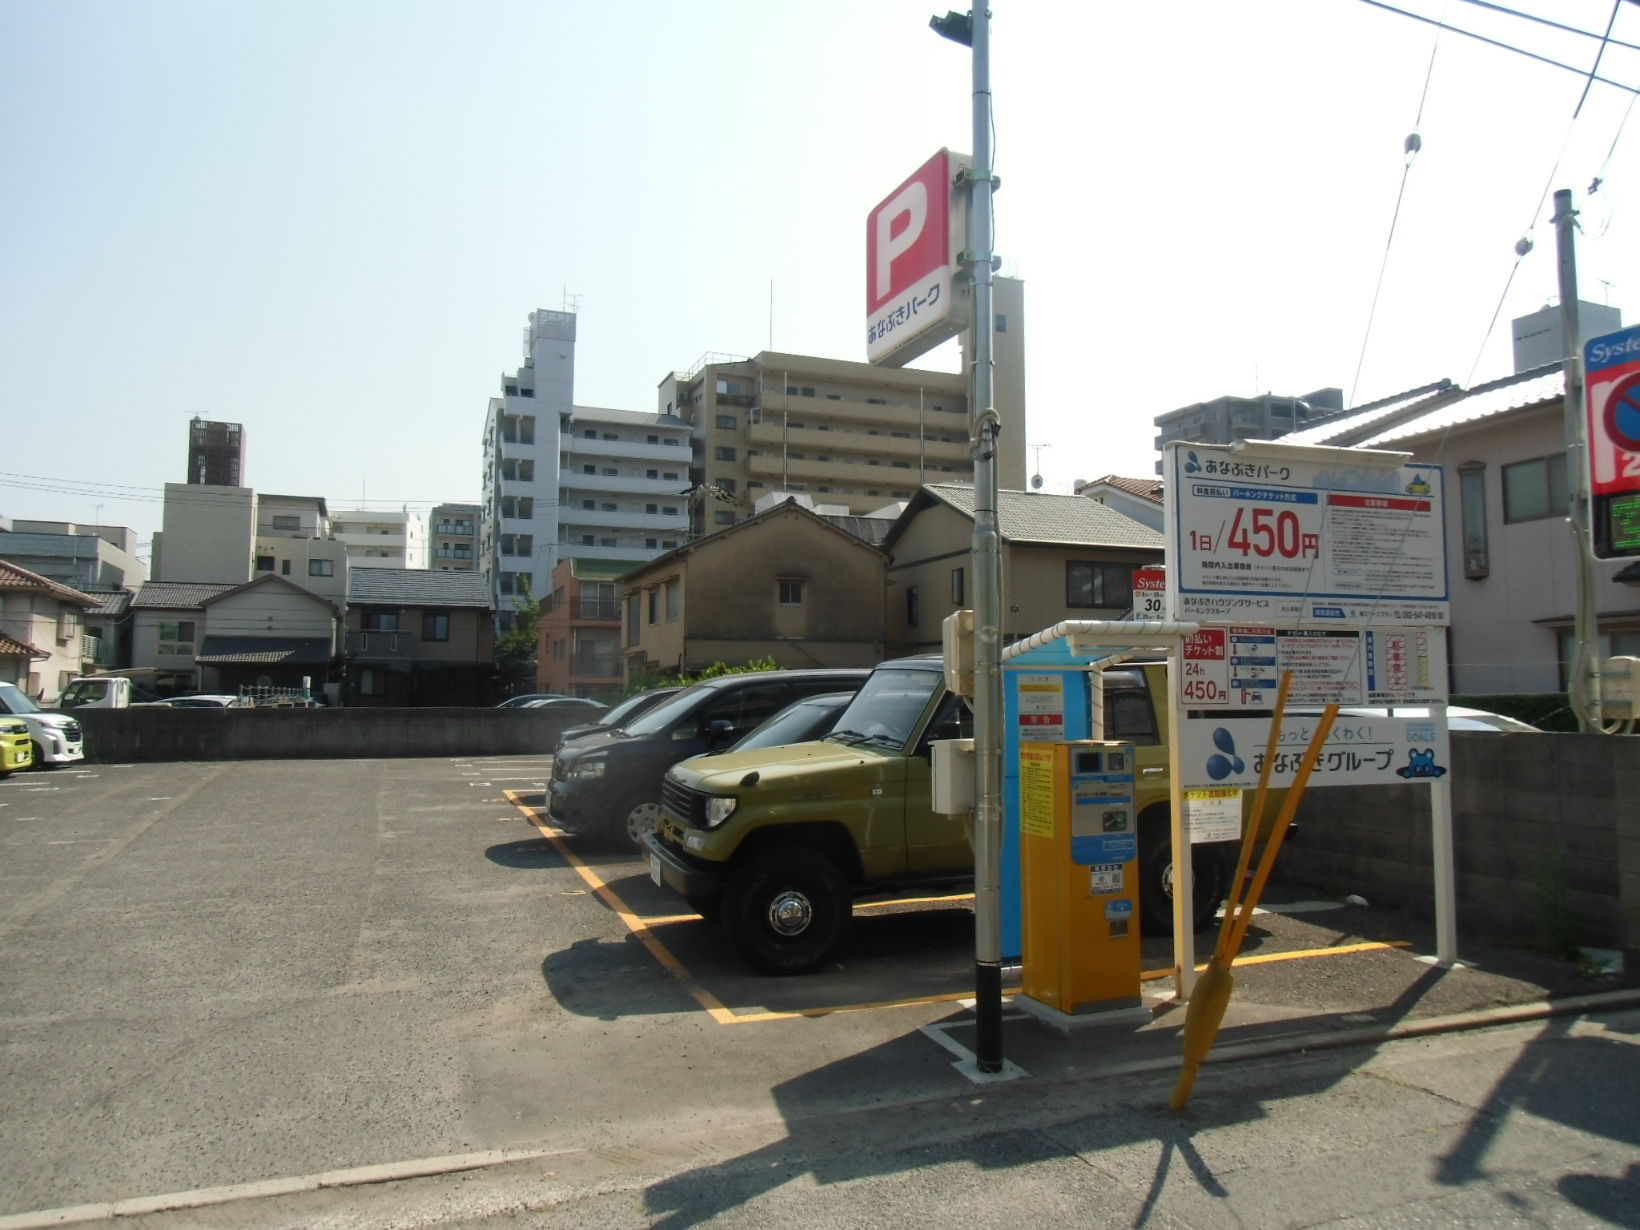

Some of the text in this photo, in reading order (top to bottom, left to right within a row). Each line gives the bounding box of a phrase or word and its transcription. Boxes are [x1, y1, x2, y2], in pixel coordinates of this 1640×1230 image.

[876, 181, 928, 301] P
[868, 283, 941, 345] あなぶきパーク
[1205, 459, 1290, 480] あなぶきパーク
[1185, 645, 1224, 656] チケット制
[1185, 662, 1205, 676] 24h
[1184, 680, 1227, 700] 450円
